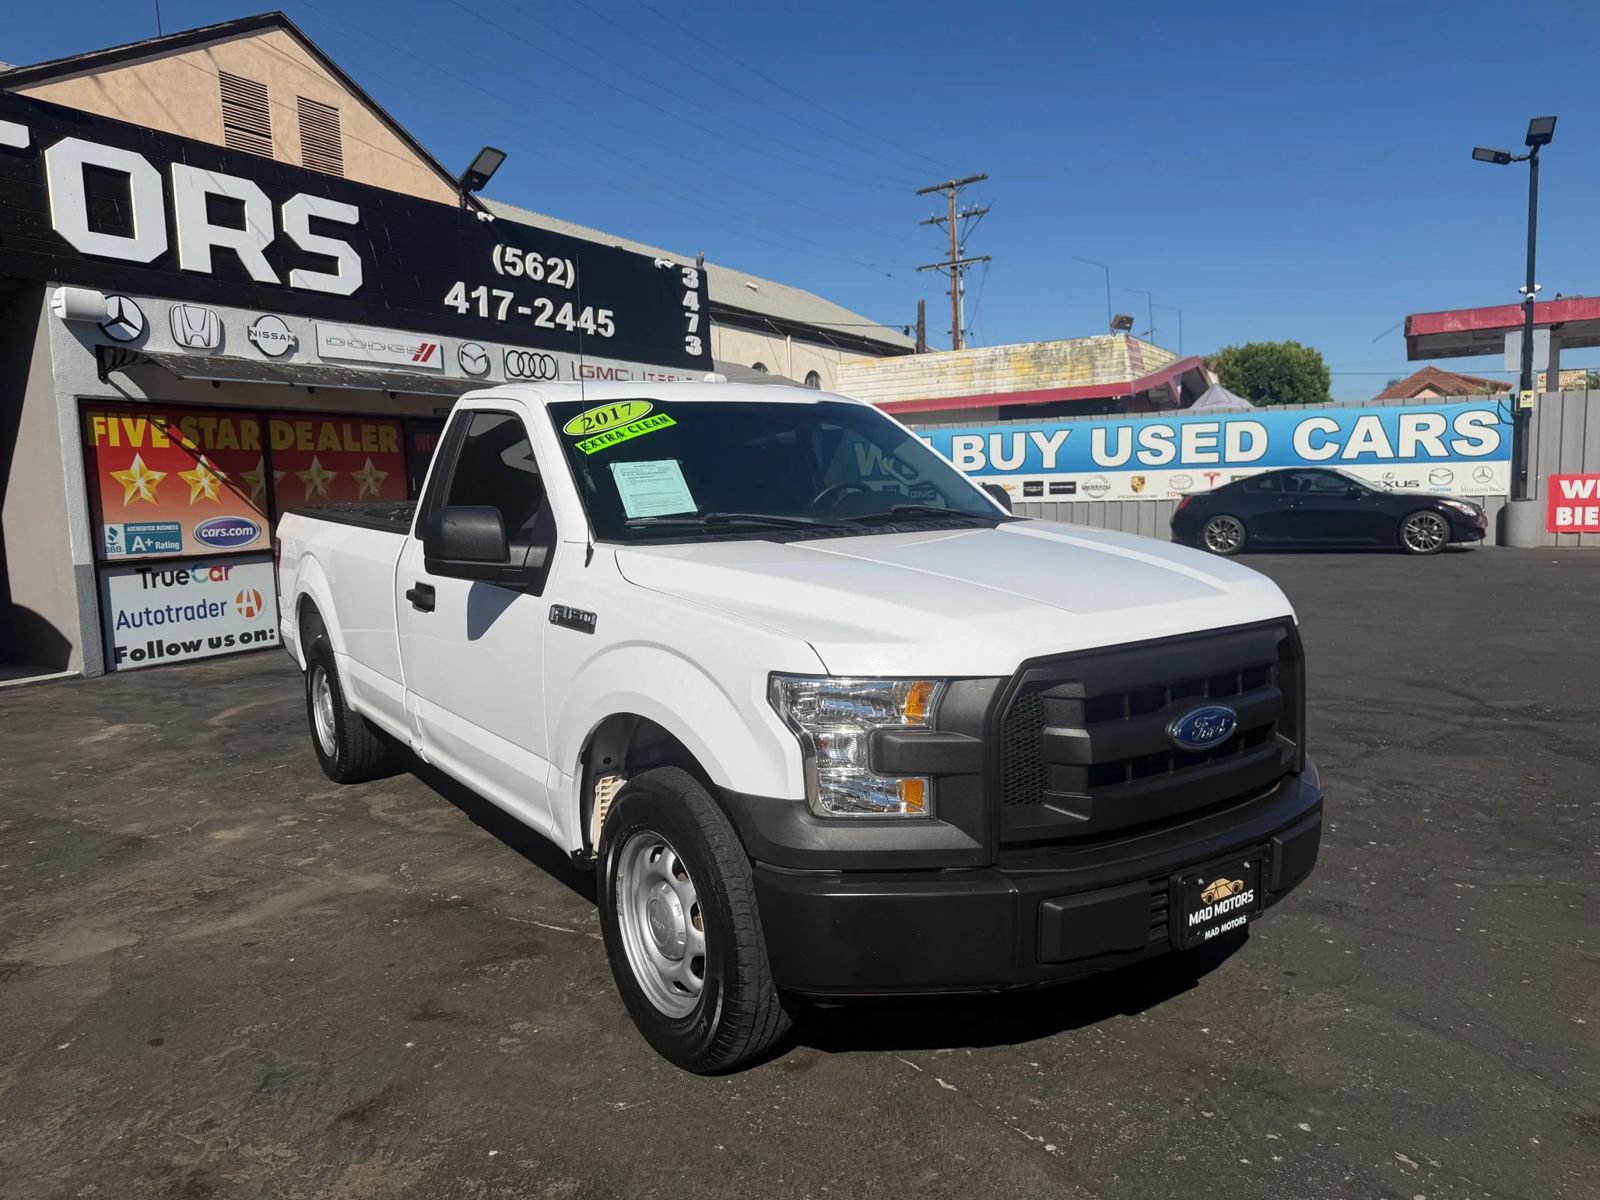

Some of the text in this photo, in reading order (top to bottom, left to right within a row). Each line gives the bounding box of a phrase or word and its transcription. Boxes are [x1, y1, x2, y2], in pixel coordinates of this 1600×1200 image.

[493, 243, 575, 289] (562)
[444, 281, 615, 338] 417-2445
[682, 267, 702, 356] 3473
[250, 329, 296, 342] NISSAN
[326, 336, 421, 354] DODGE
[579, 365, 629, 382] GMC
[86, 411, 169, 448] FIVE
[180, 416, 260, 450] STAR
[269, 418, 399, 453] DEALER
[580, 403, 633, 432] 2017
[580, 414, 669, 451] EXTRA CLEAN
[952, 429, 1072, 472] BUY
[1091, 419, 1269, 467] USED
[1293, 409, 1501, 461] CARS
[132, 536, 180, 552] A+ Rating
[201, 526, 253, 538] cars.com
[105, 545, 122, 553] BBB
[136, 562, 233, 591] TrueCar
[116, 597, 227, 630] Autotrader
[114, 627, 276, 664] Follow us on:
[1189, 889, 1254, 927] MAD MOTORS
[1204, 915, 1247, 940] MAD MOTORS
